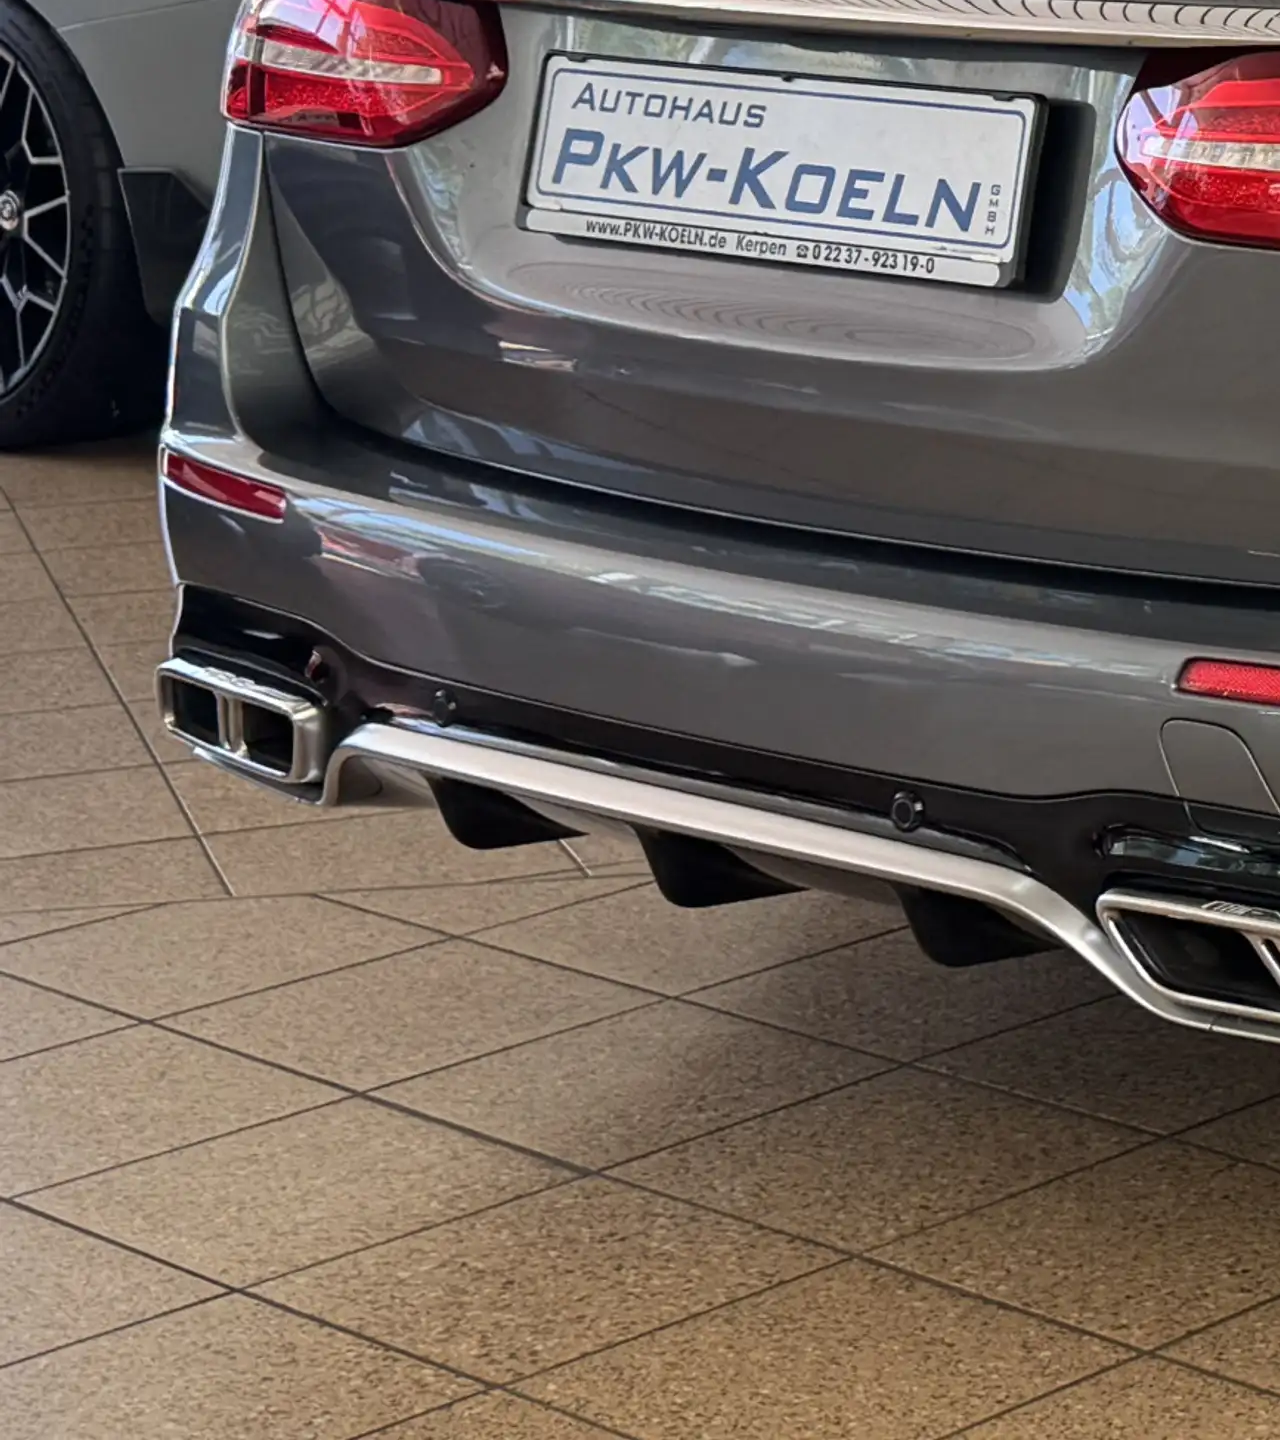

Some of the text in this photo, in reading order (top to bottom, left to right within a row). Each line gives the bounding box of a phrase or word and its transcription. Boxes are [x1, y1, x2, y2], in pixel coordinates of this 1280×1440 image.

[571, 82, 768, 128] AUTOHAUS
[551, 127, 983, 232] PKW-KOELN
[585, 219, 727, 248] www.PKW-KOELN.de
[735, 233, 788, 257] Kerpen
